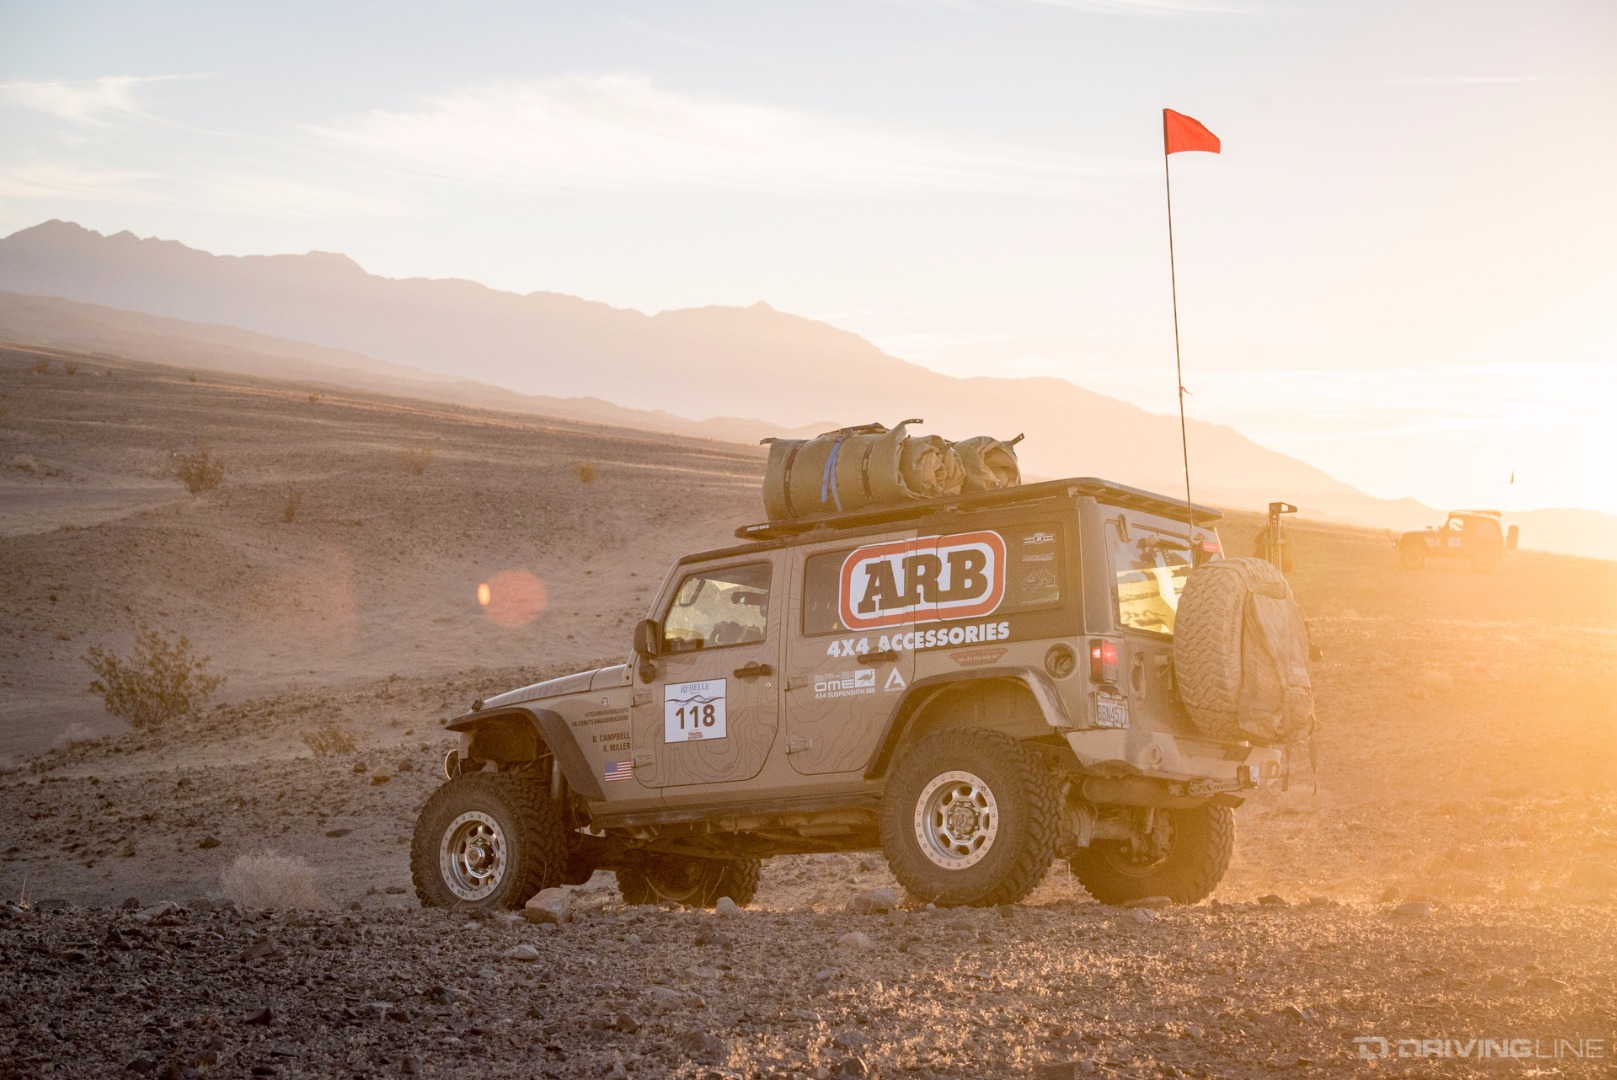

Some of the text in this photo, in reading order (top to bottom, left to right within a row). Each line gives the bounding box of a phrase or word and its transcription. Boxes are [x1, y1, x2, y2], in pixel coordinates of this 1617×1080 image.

[857, 549, 988, 614] ARB
[827, 622, 1010, 658] 4X4 ACCESSORIES
[680, 683, 710, 694] REBELLE
[827, 688, 865, 698] SUSPENSION
[675, 704, 715, 730] 118
[592, 732, 631, 743] B. CAMPBELL
[603, 742, 631, 752] K. MILLER
